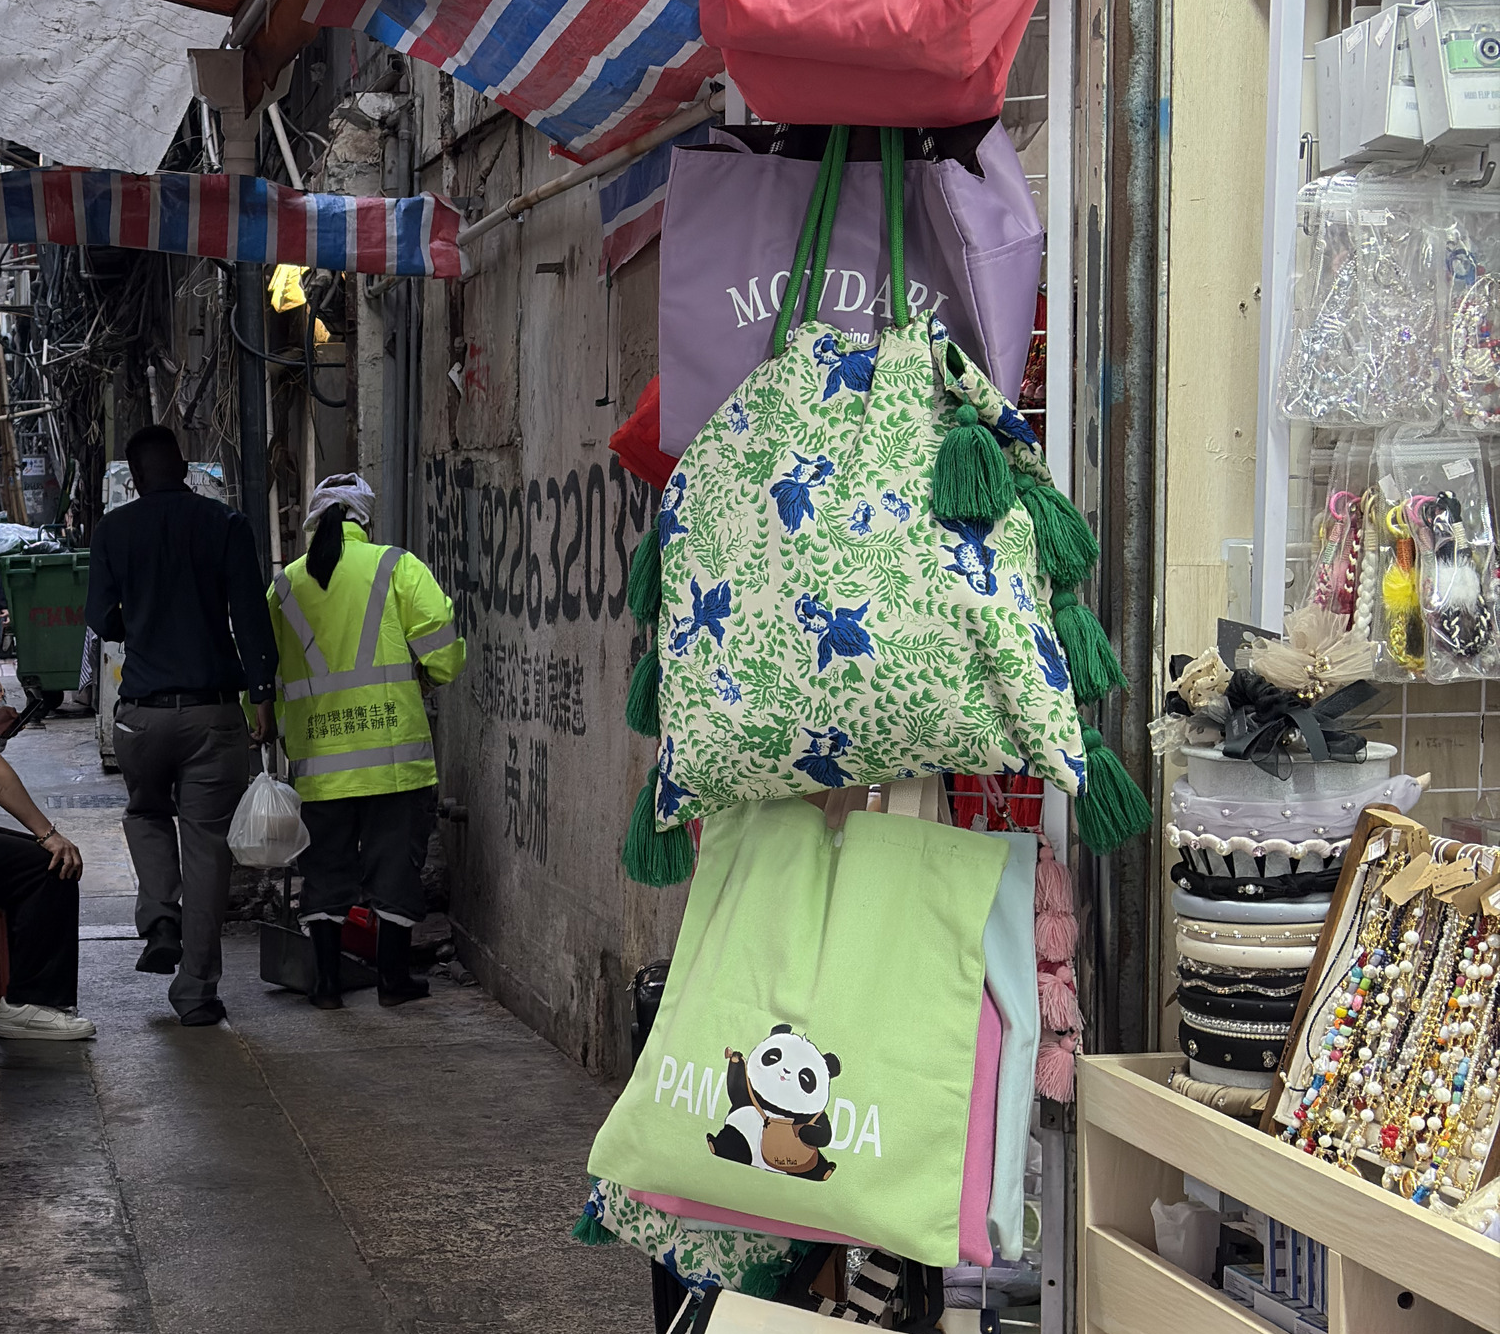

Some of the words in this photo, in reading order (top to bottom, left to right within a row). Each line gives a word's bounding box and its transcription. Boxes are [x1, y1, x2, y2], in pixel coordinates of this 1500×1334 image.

[480, 453, 628, 631] 92263203
[654, 1055, 727, 1120] PAN
[829, 1097, 882, 1158] DA
[774, 1156, 786, 1165] Hua
[786, 1157, 798, 1166] Hua
